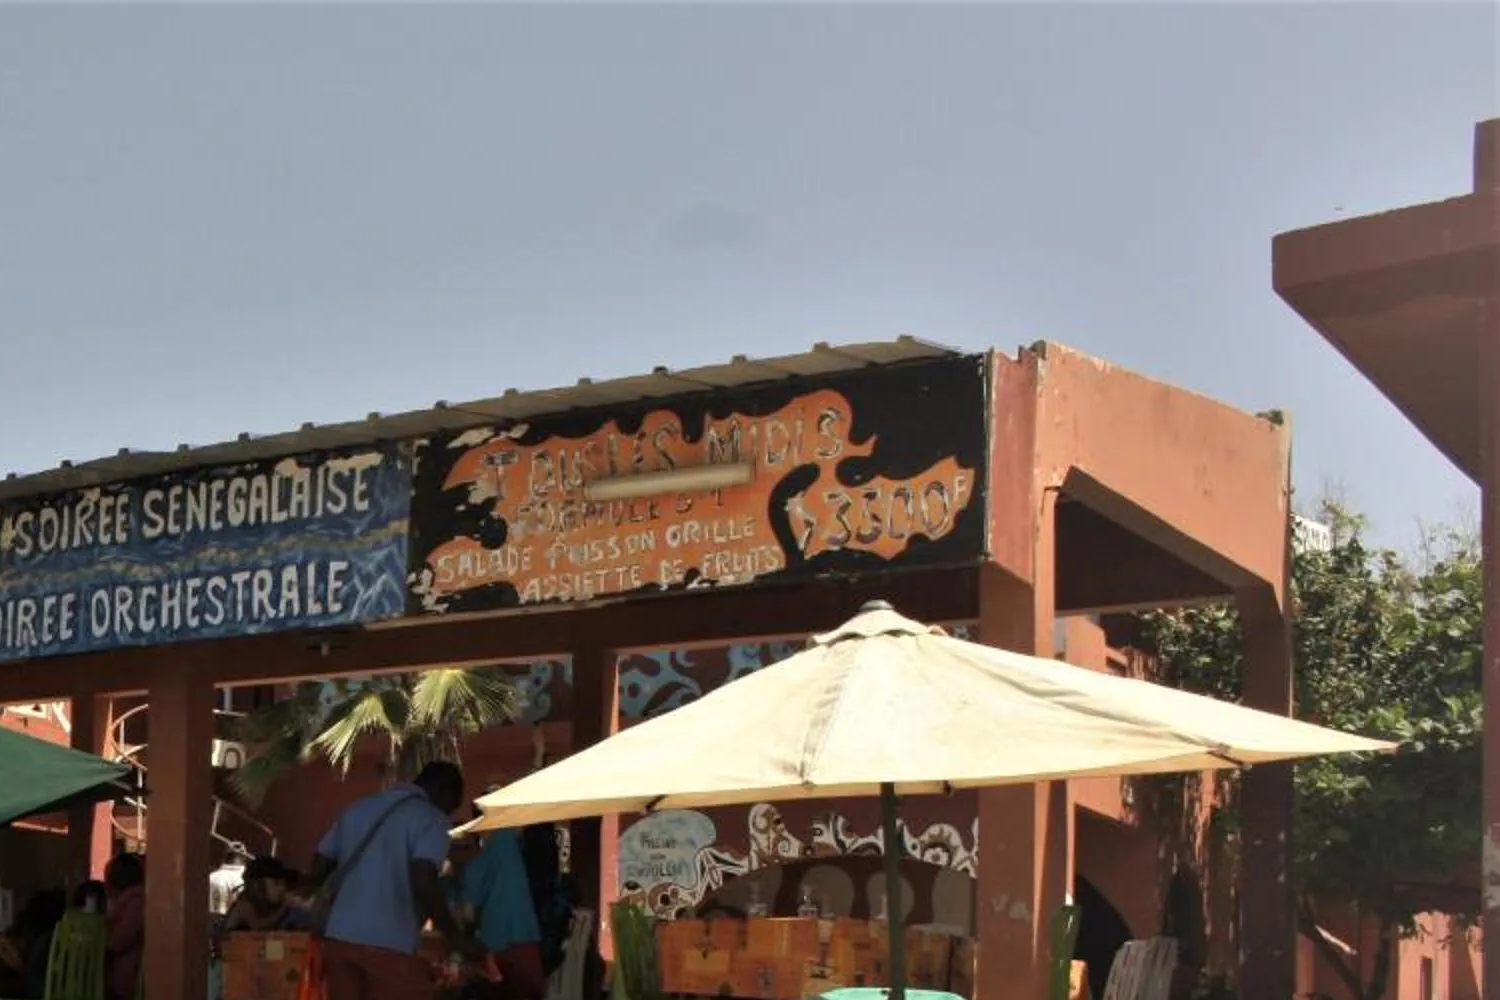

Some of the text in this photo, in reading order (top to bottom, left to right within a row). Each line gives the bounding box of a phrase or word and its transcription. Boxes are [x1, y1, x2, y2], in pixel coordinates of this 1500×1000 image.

[437, 545, 532, 584] SALADE
[521, 565, 642, 603] ASSIETTE
[702, 545, 780, 579] FRUITS
[91, 561, 349, 638] ORCHESTRALE
